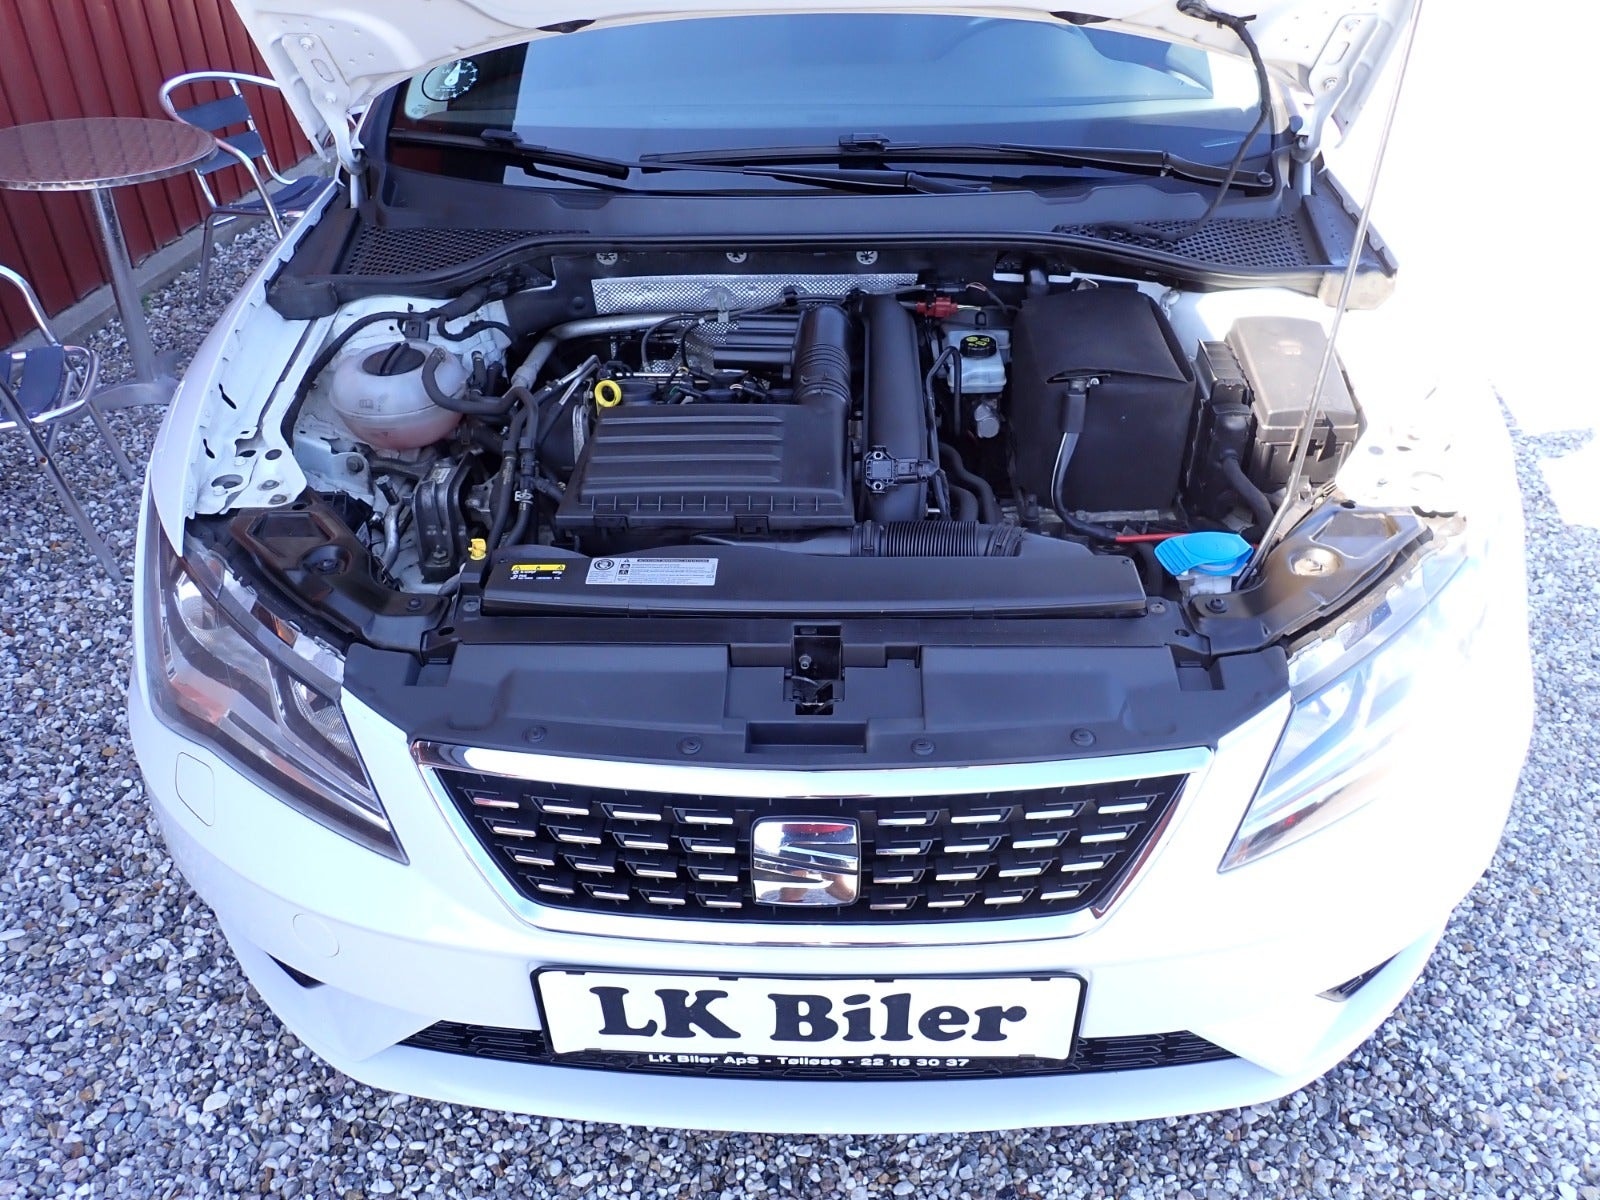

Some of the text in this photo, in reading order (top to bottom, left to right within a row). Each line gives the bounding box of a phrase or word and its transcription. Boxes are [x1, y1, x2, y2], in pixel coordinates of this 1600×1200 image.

[589, 986, 1027, 1042] LK Biler
[648, 1054, 672, 1063] LK
[677, 1055, 719, 1064] Biler
[723, 1055, 760, 1066] ApS
[860, 1058, 884, 1066] 22
[889, 1058, 911, 1067] 16
[916, 1058, 941, 1067] 30
[945, 1058, 970, 1067] 37
